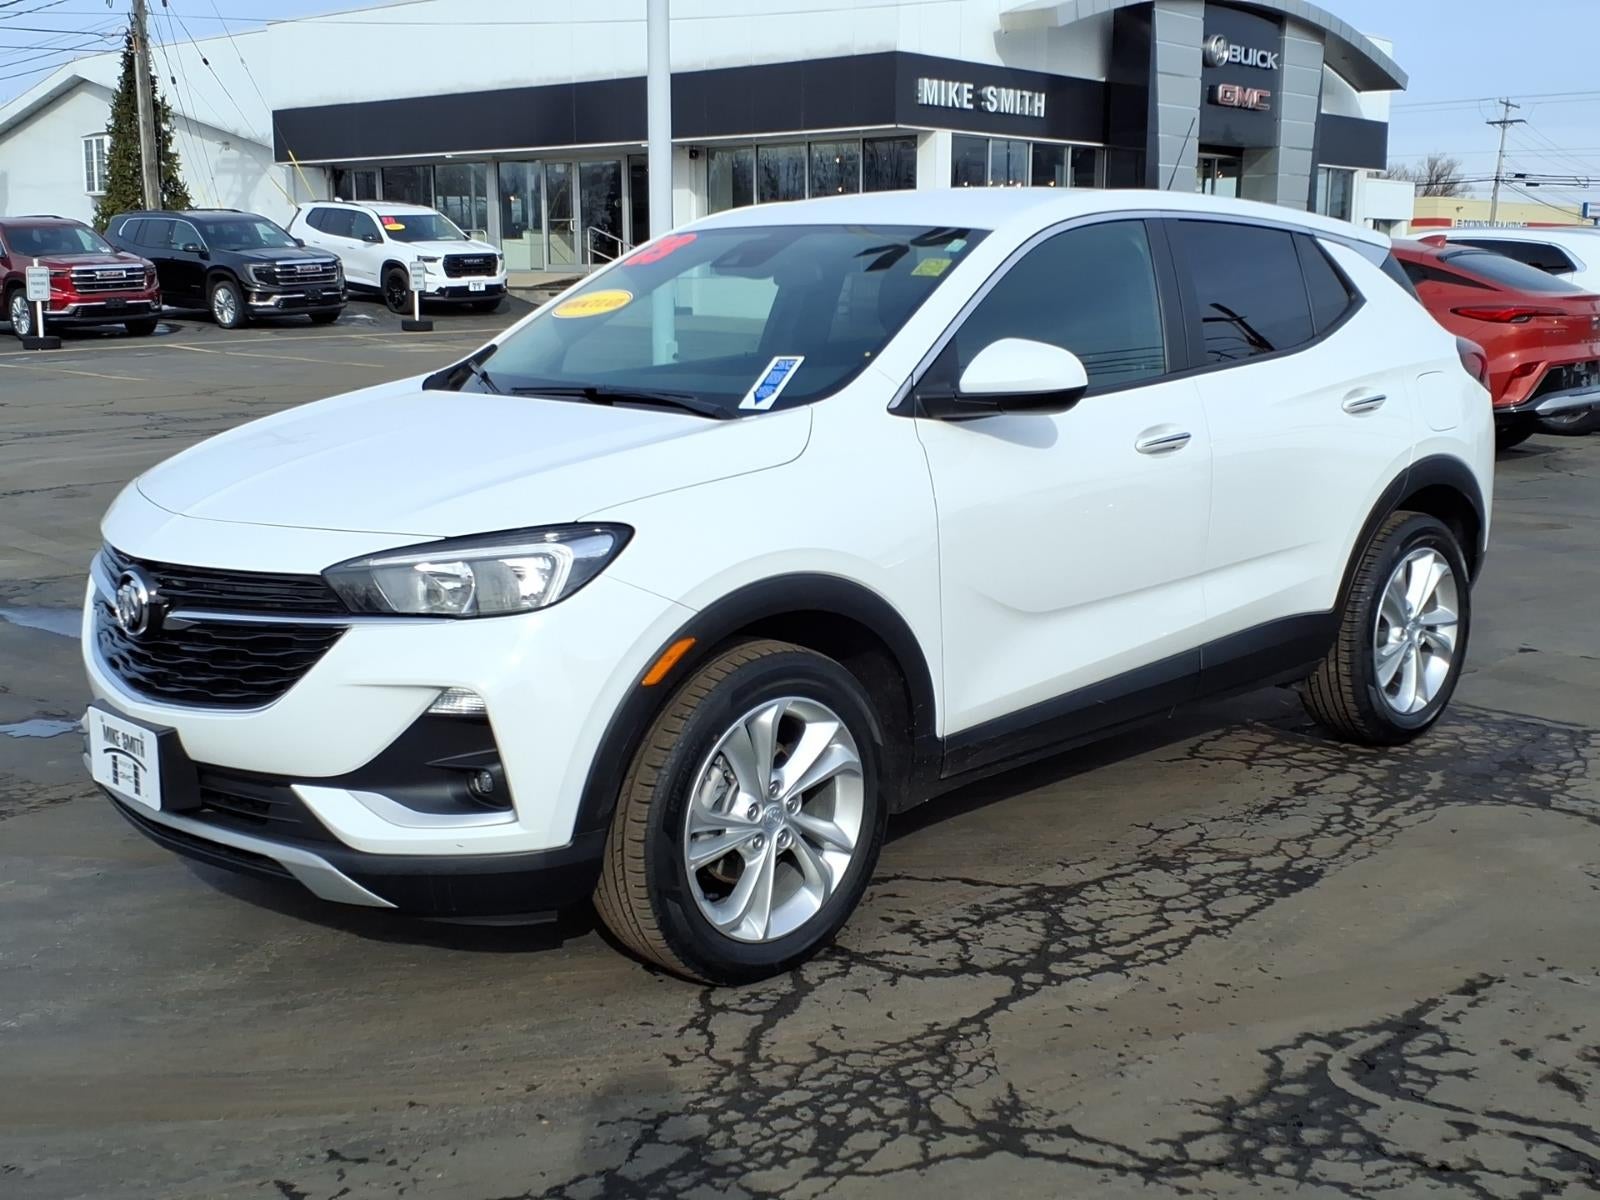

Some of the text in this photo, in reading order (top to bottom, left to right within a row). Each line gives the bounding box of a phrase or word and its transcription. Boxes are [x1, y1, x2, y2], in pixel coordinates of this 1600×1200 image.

[1228, 44, 1278, 69] BUICK
[919, 78, 1045, 117] MIKE SMITH
[1218, 84, 1270, 110] GMC
[103, 724, 145, 758] MIKE SMITH
